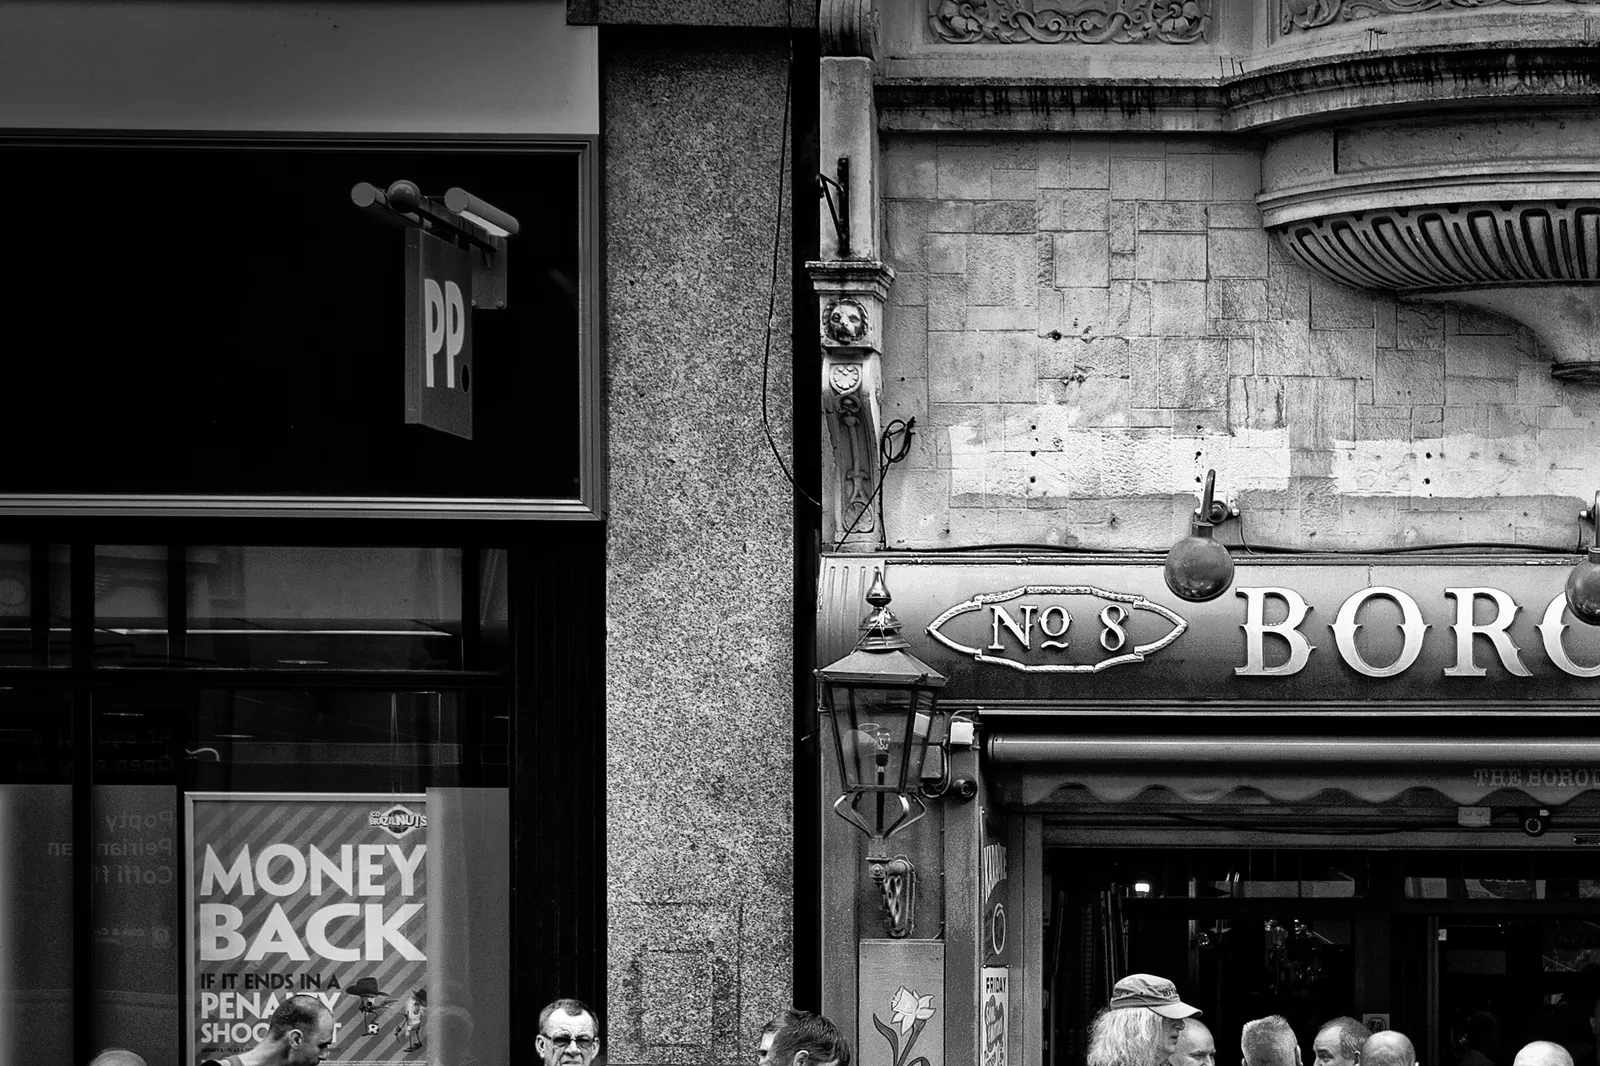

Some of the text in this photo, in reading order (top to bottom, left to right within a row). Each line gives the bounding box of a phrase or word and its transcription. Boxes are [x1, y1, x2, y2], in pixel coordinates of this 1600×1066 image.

[1098, 604, 1128, 652] 8
[1474, 768, 1522, 787] THE
[200, 843, 427, 897] MONEY
[200, 902, 427, 961] BACK
[200, 973, 342, 989] IF IT ENDS IN A
[985, 977, 1006, 993] FRIDAY
